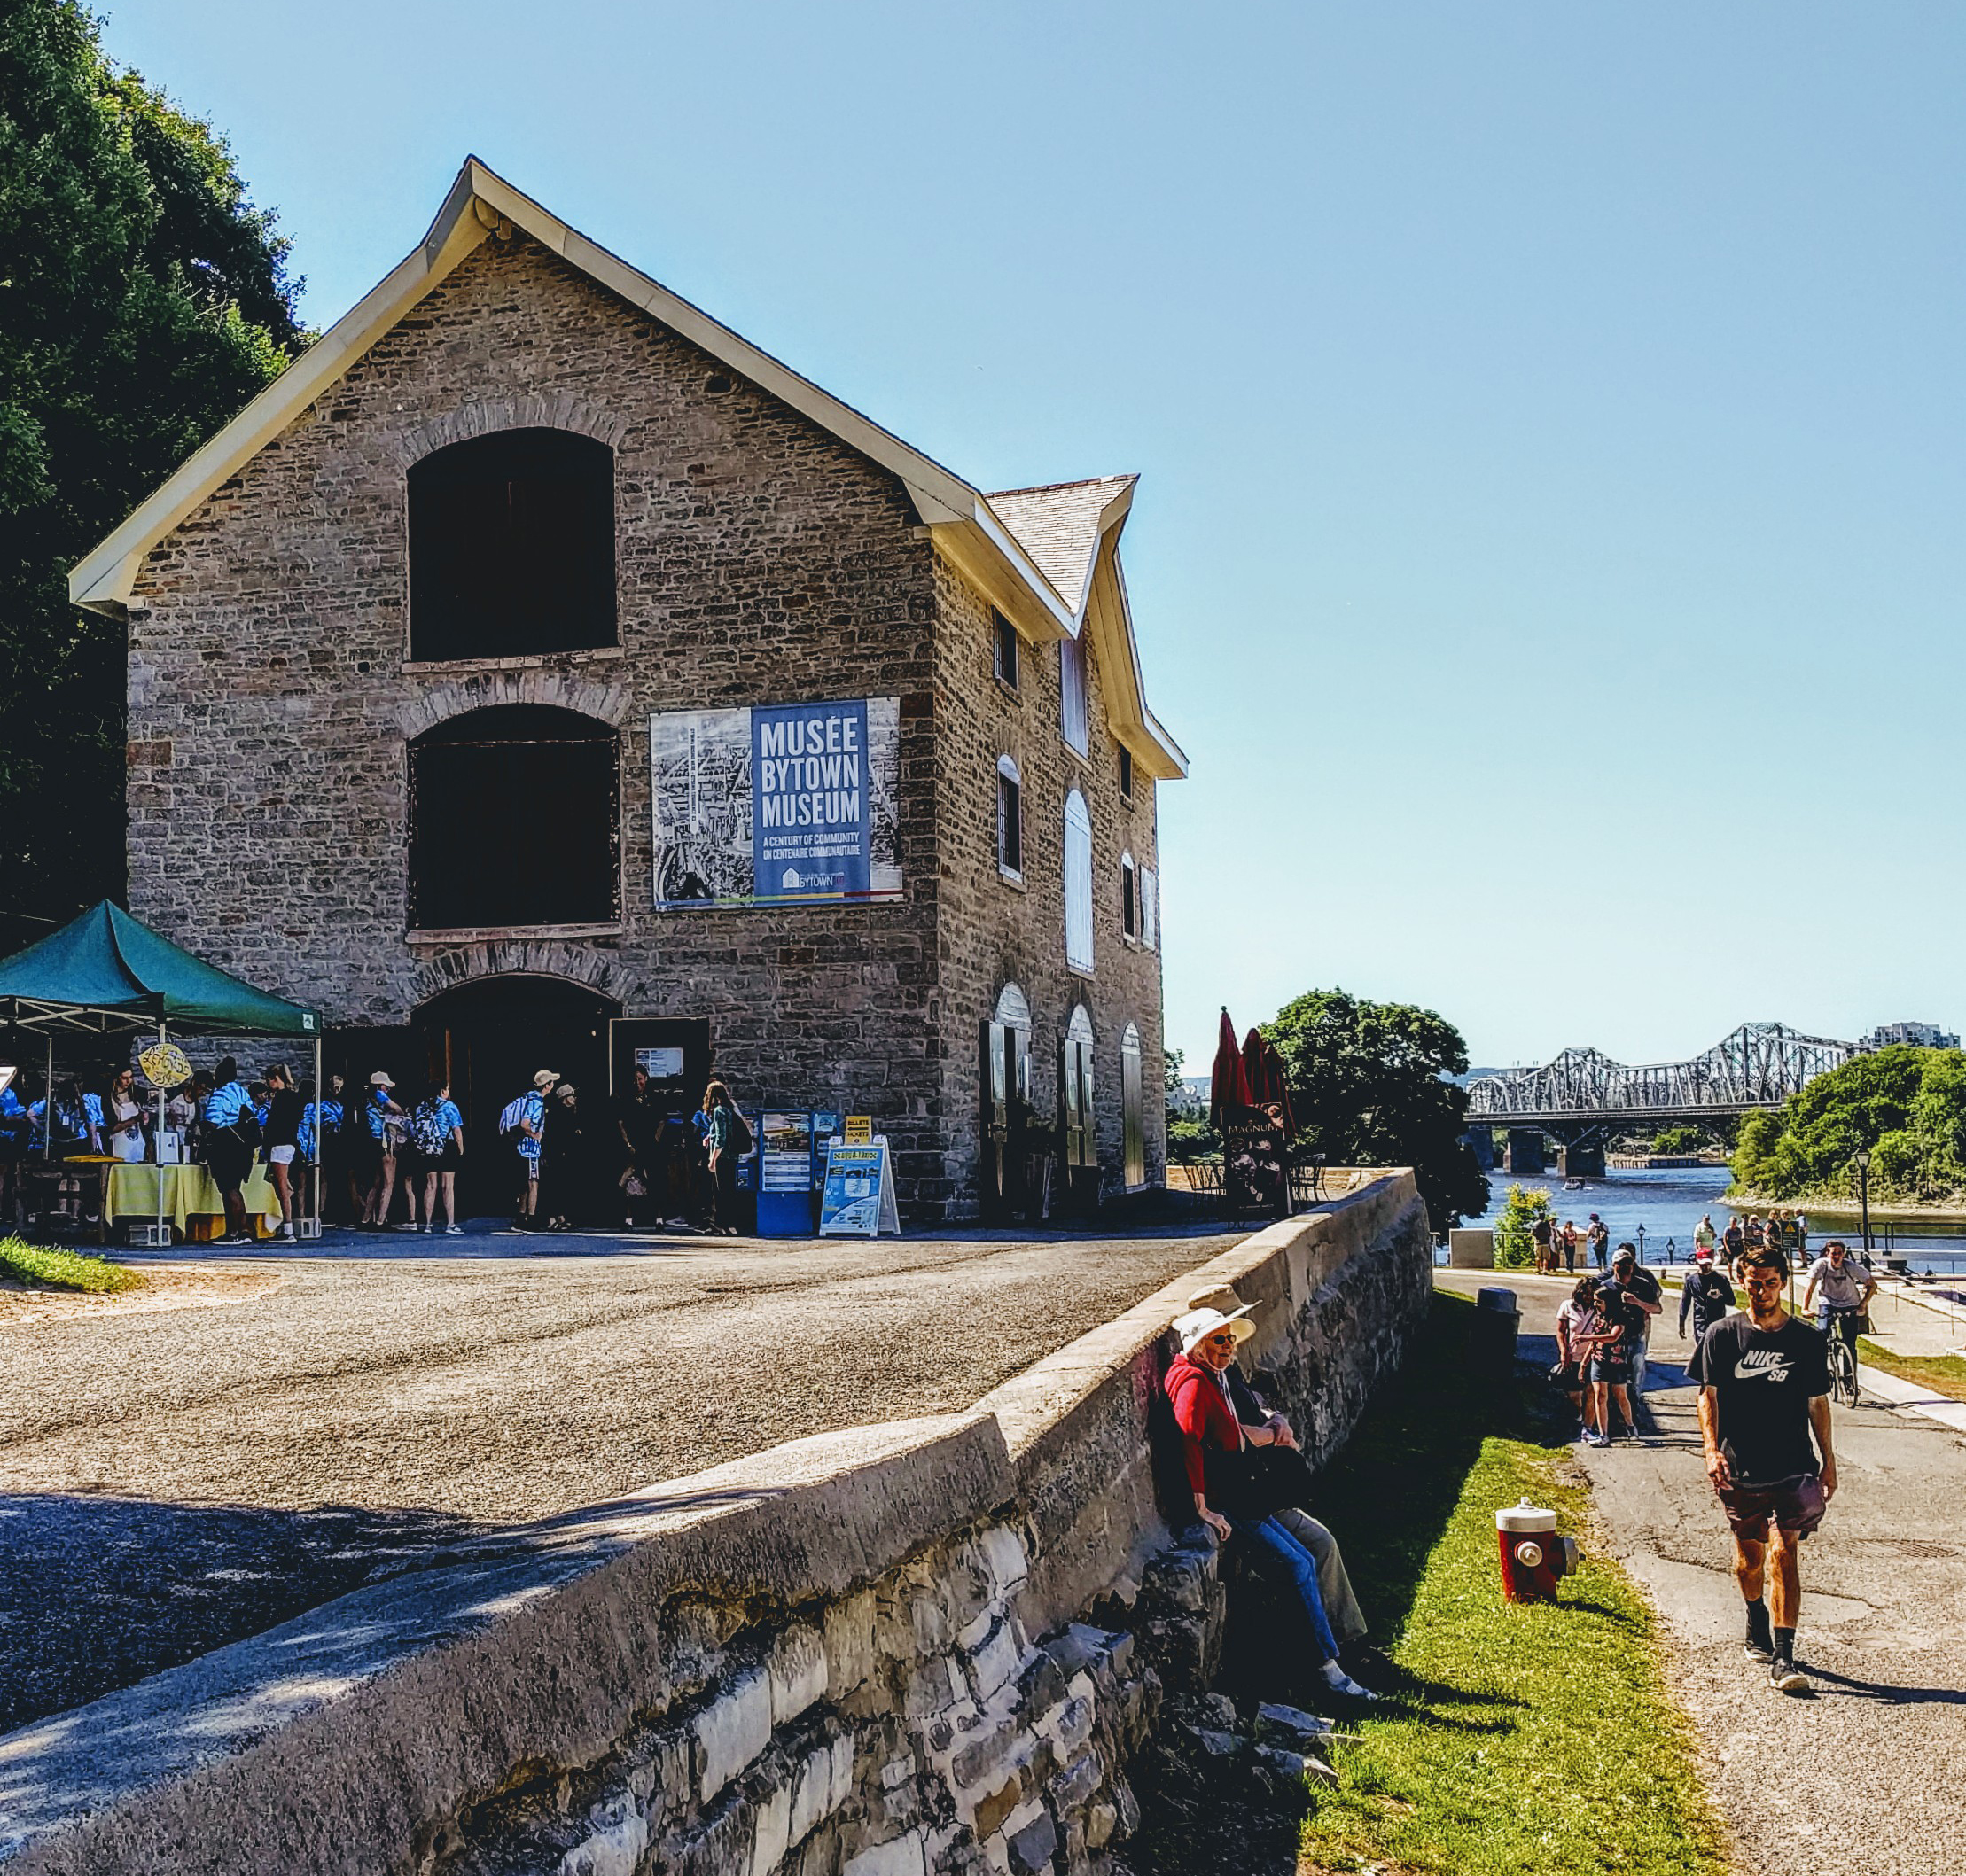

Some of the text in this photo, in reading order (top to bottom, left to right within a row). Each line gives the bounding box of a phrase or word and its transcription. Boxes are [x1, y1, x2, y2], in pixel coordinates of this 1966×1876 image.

[761, 715, 859, 757] MUSÉE
[761, 754, 859, 793] BYTOWN
[762, 790, 860, 828] MUSEUM
[763, 832, 860, 847] A CENTURY OF COMMUNITY
[763, 849, 772, 860] UN
[773, 847, 808, 860] CENTENAIRE
[800, 876, 833, 888] BYTOWN
[1229, 1123, 1278, 1134] MAGNUM
[1742, 1350, 1785, 1366] NIKE
[1767, 1369, 1789, 1382] SB
